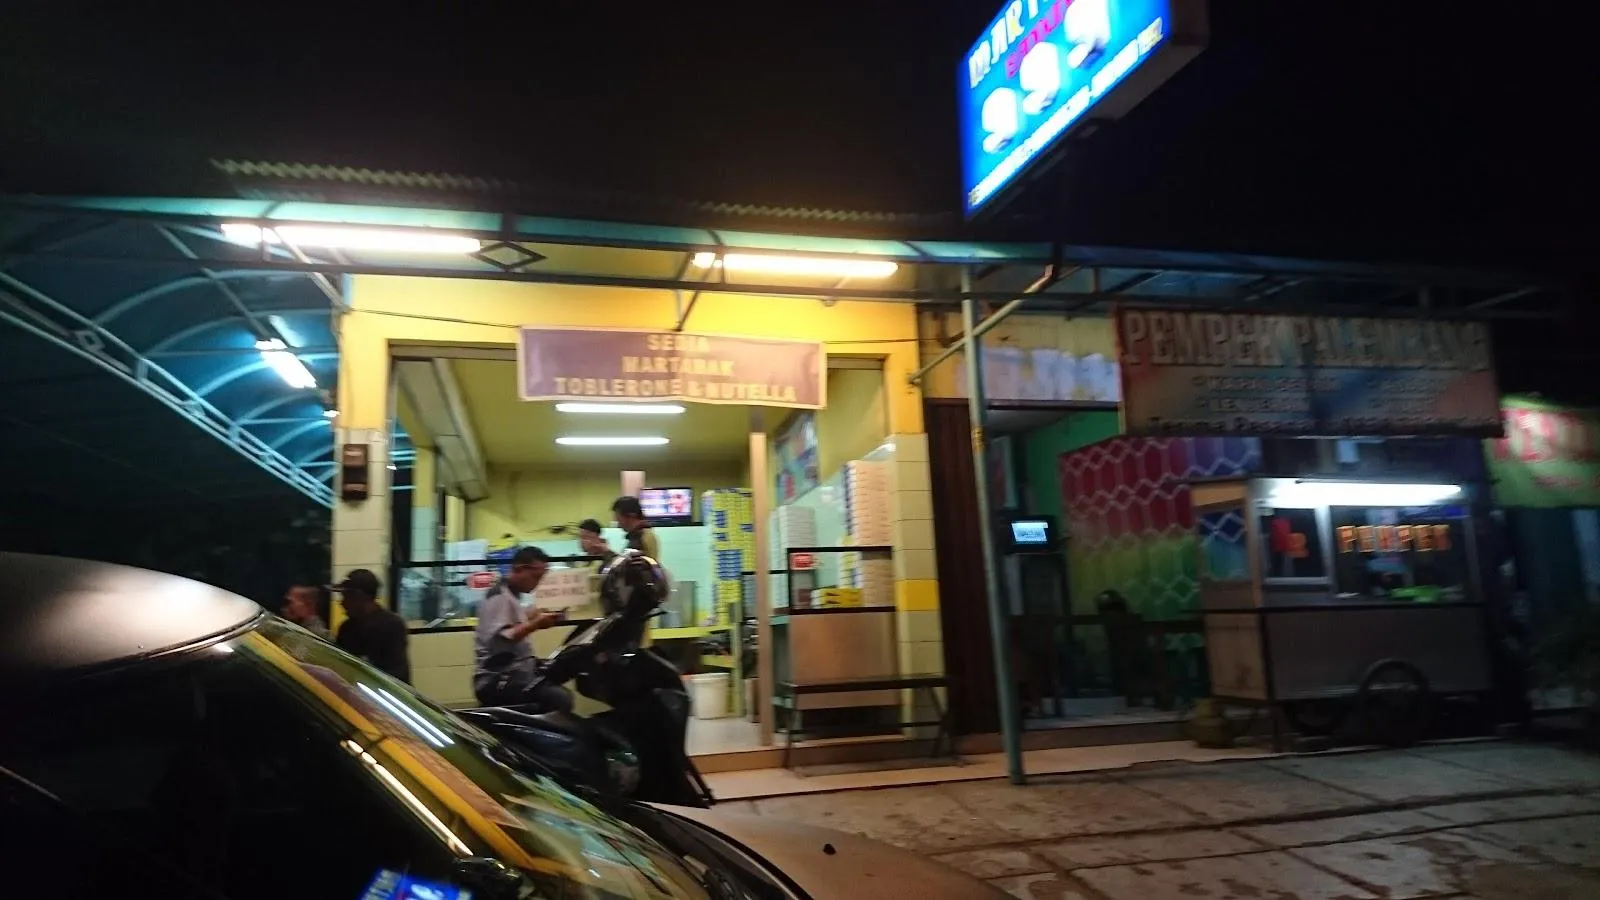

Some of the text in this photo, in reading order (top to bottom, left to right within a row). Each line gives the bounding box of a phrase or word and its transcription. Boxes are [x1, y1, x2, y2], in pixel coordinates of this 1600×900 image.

[647, 334, 711, 351] SEDIA
[1121, 311, 1284, 367] PEMPEK
[621, 356, 735, 377] MARTABAK
[554, 377, 682, 397] TOBLERONE
[706, 382, 798, 403] NUTELLA
